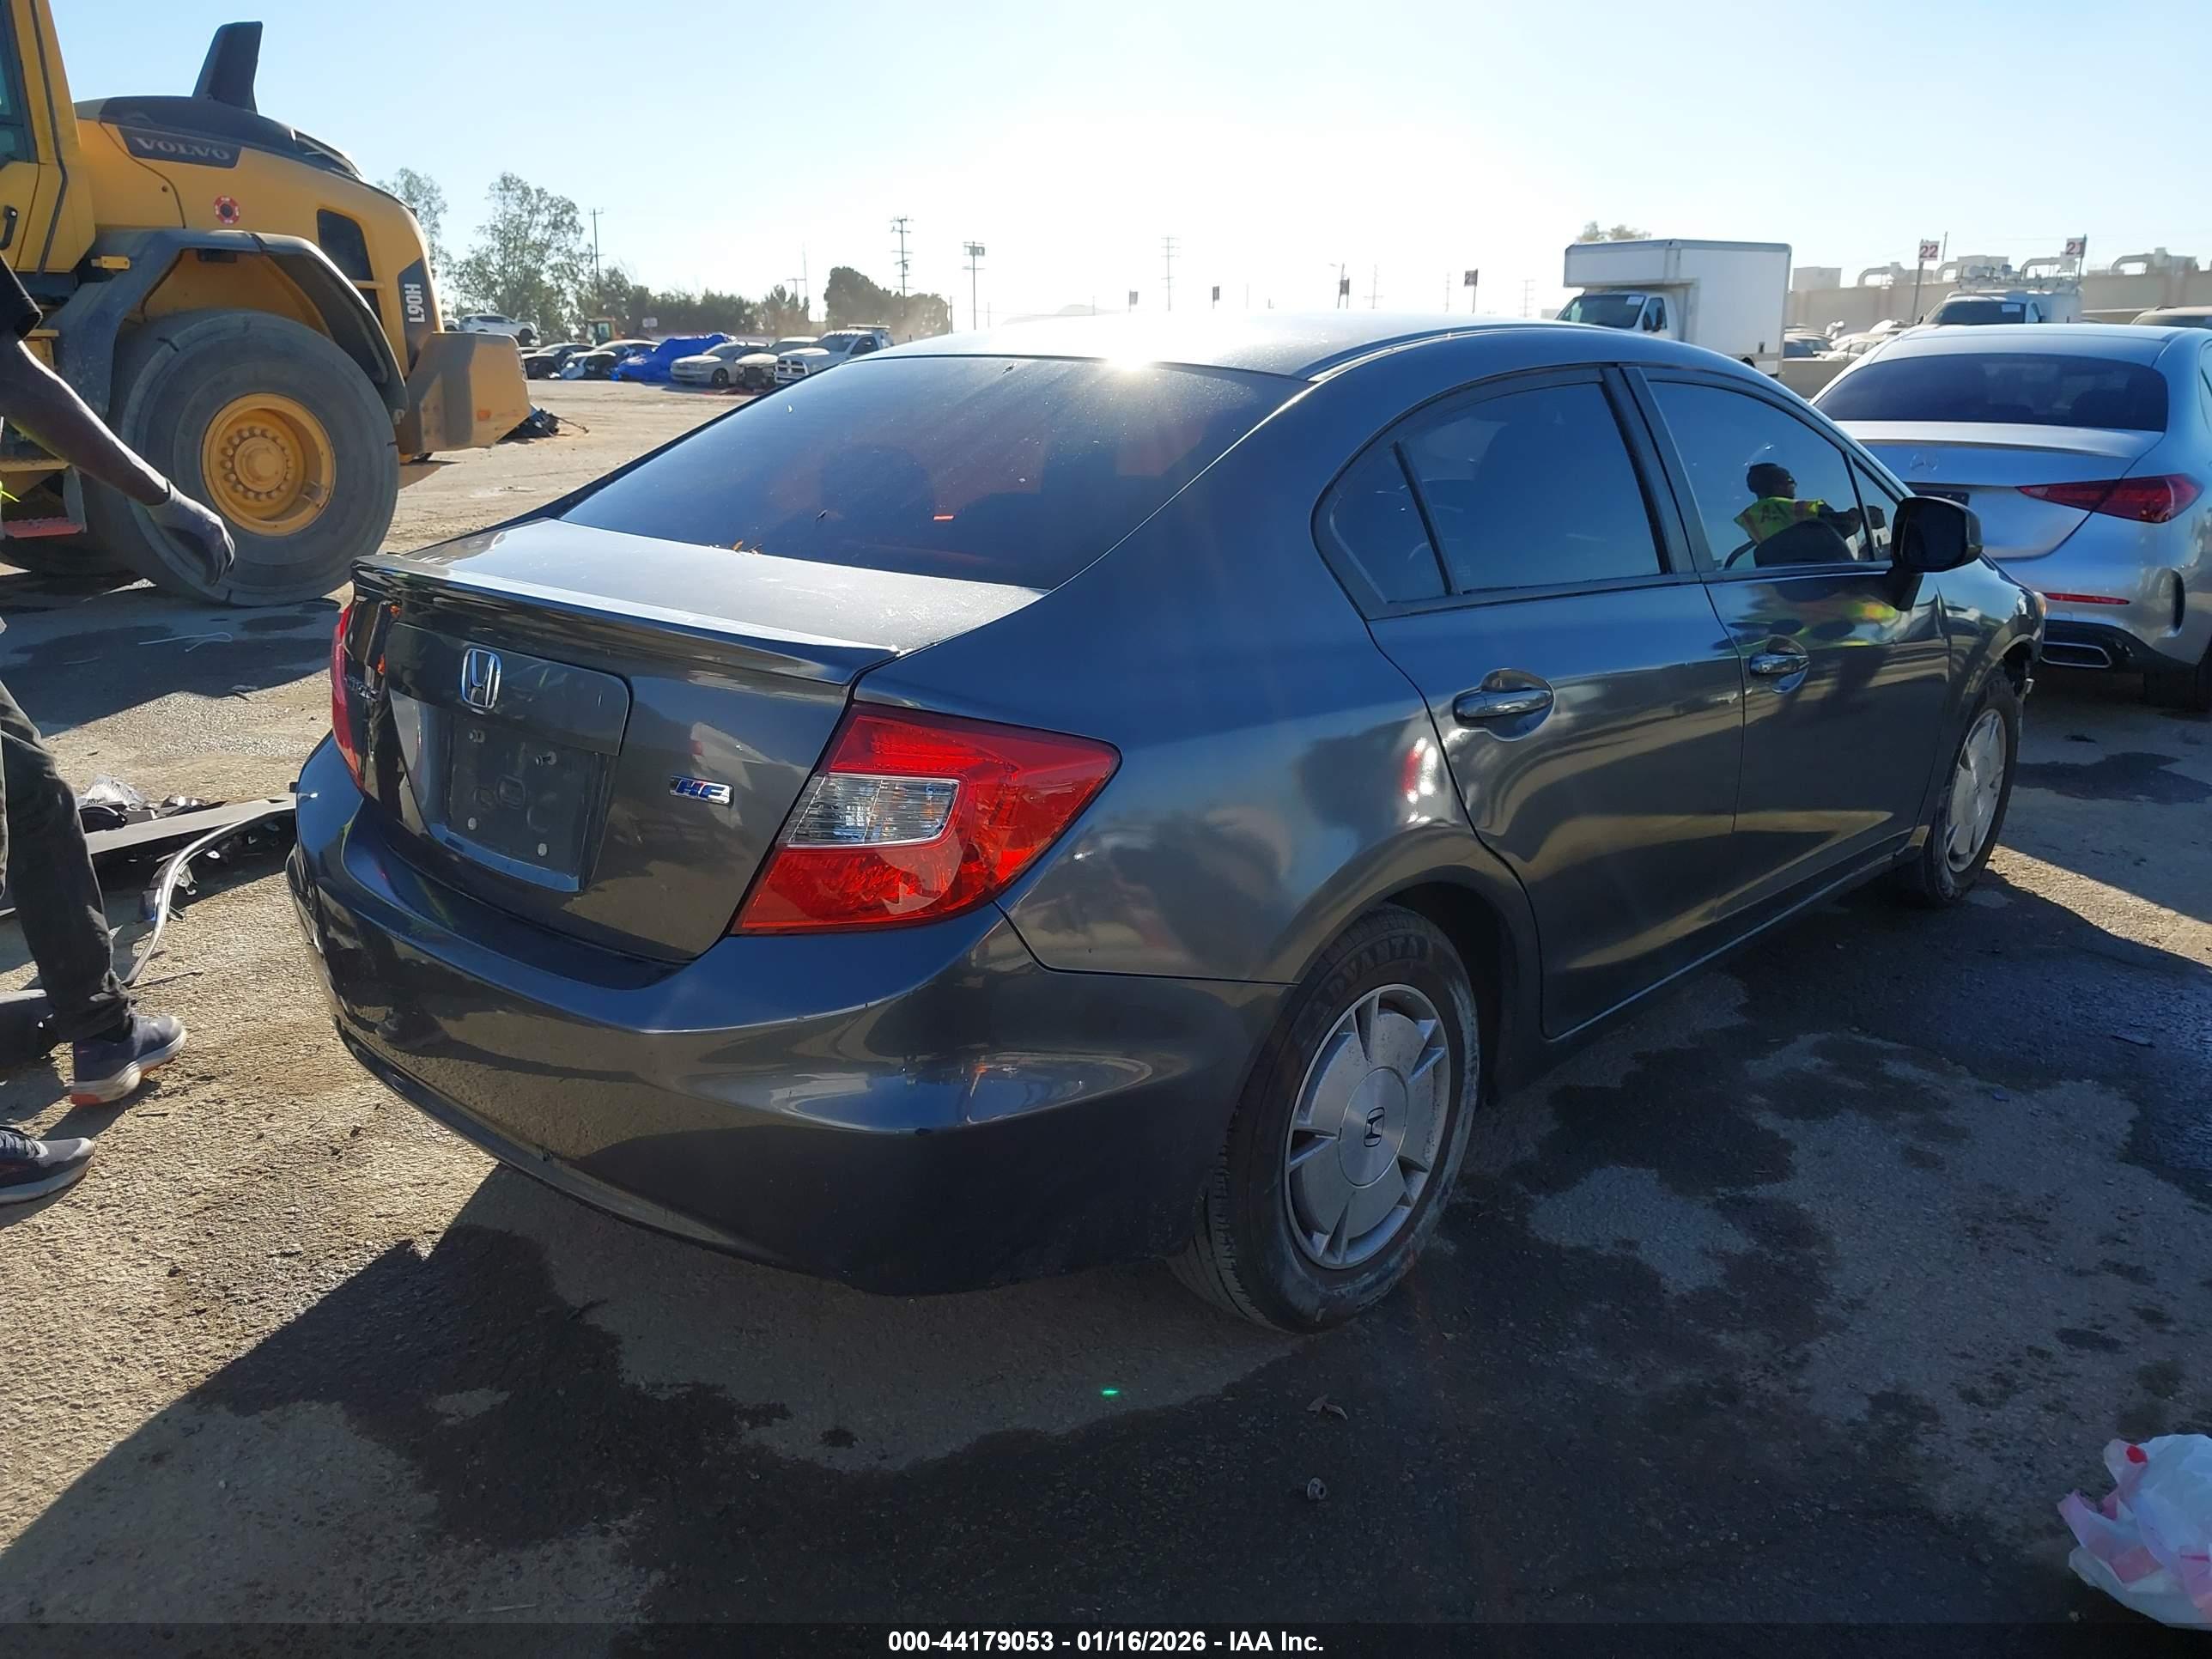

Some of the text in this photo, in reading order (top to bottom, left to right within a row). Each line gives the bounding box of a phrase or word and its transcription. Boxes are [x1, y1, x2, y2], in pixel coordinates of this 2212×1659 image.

[134, 137, 231, 161] VOLVO
[1918, 244, 1939, 258] 22
[404, 283, 426, 323] L90H
